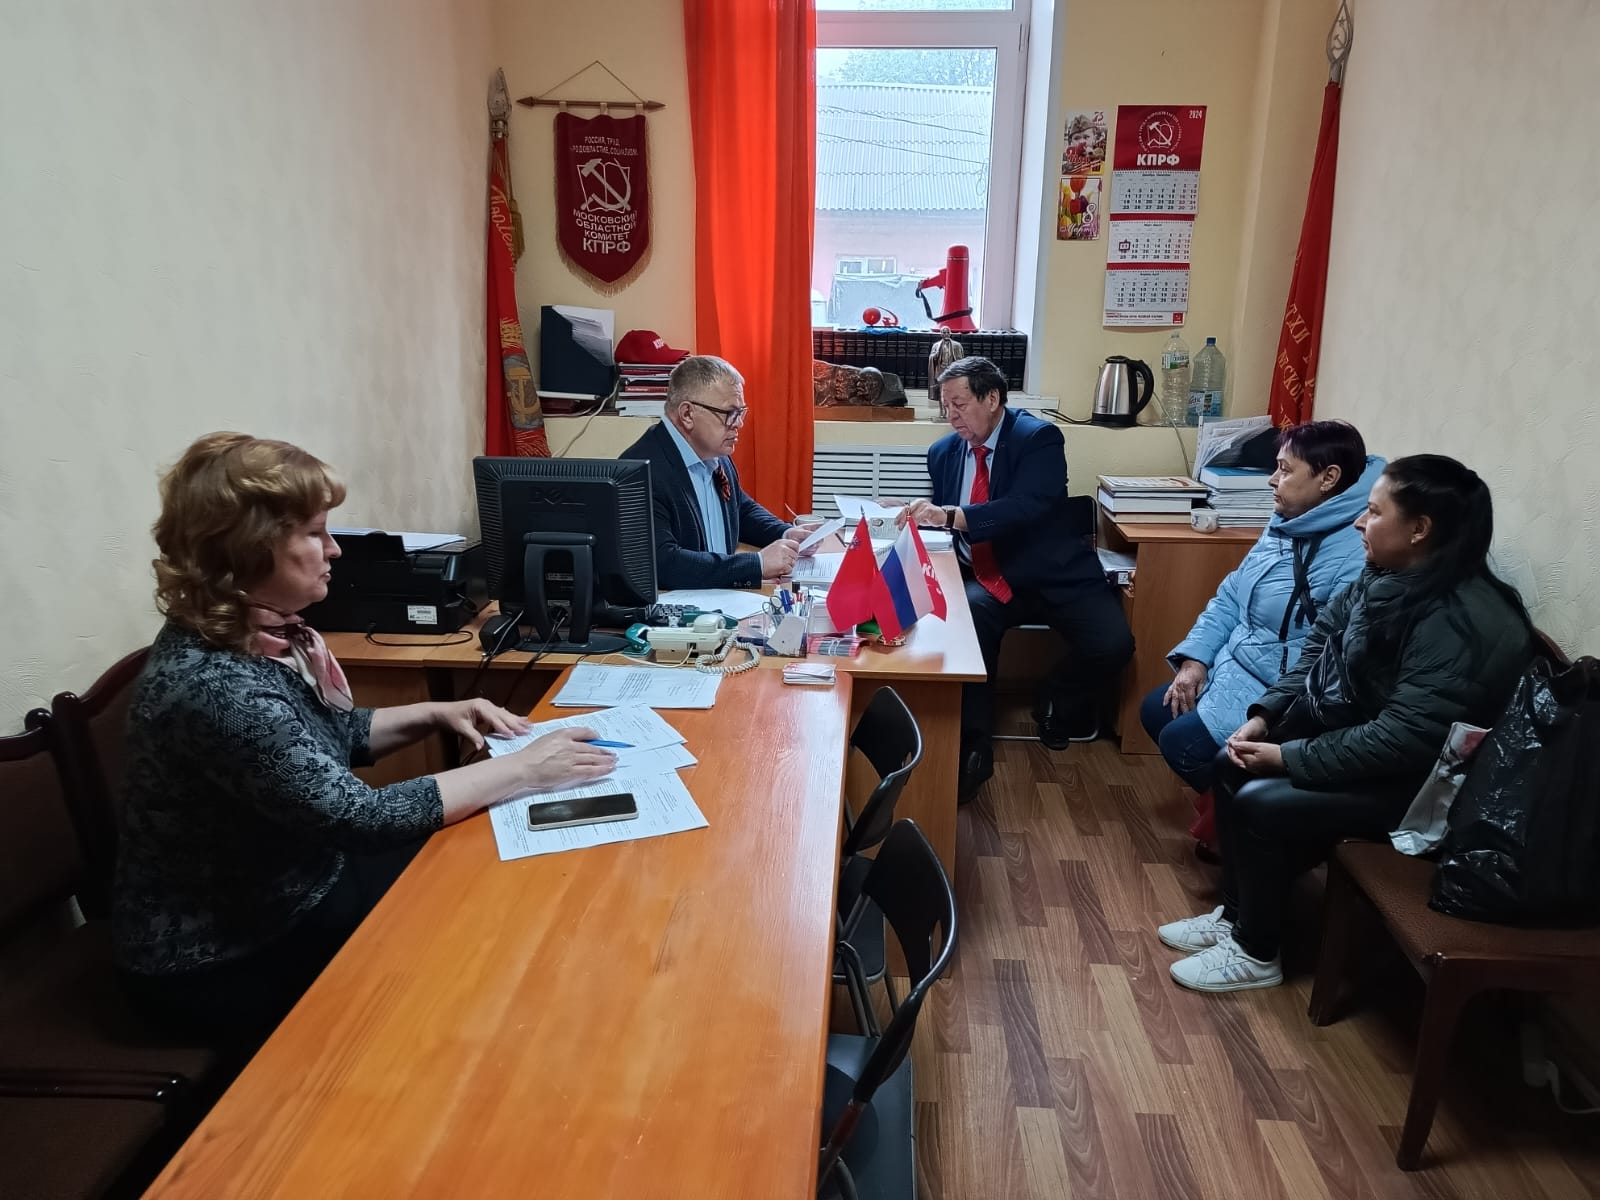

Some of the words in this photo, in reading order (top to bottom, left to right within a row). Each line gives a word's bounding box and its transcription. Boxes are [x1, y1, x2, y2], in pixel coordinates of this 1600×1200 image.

[1137, 154, 1180, 166] КПРФ
[1082, 203, 1097, 224] 8
[575, 219, 636, 233] ОБЛАСТНОЙ
[584, 230, 630, 240] КОМИТЕТ
[583, 238, 631, 254] КПРФ
